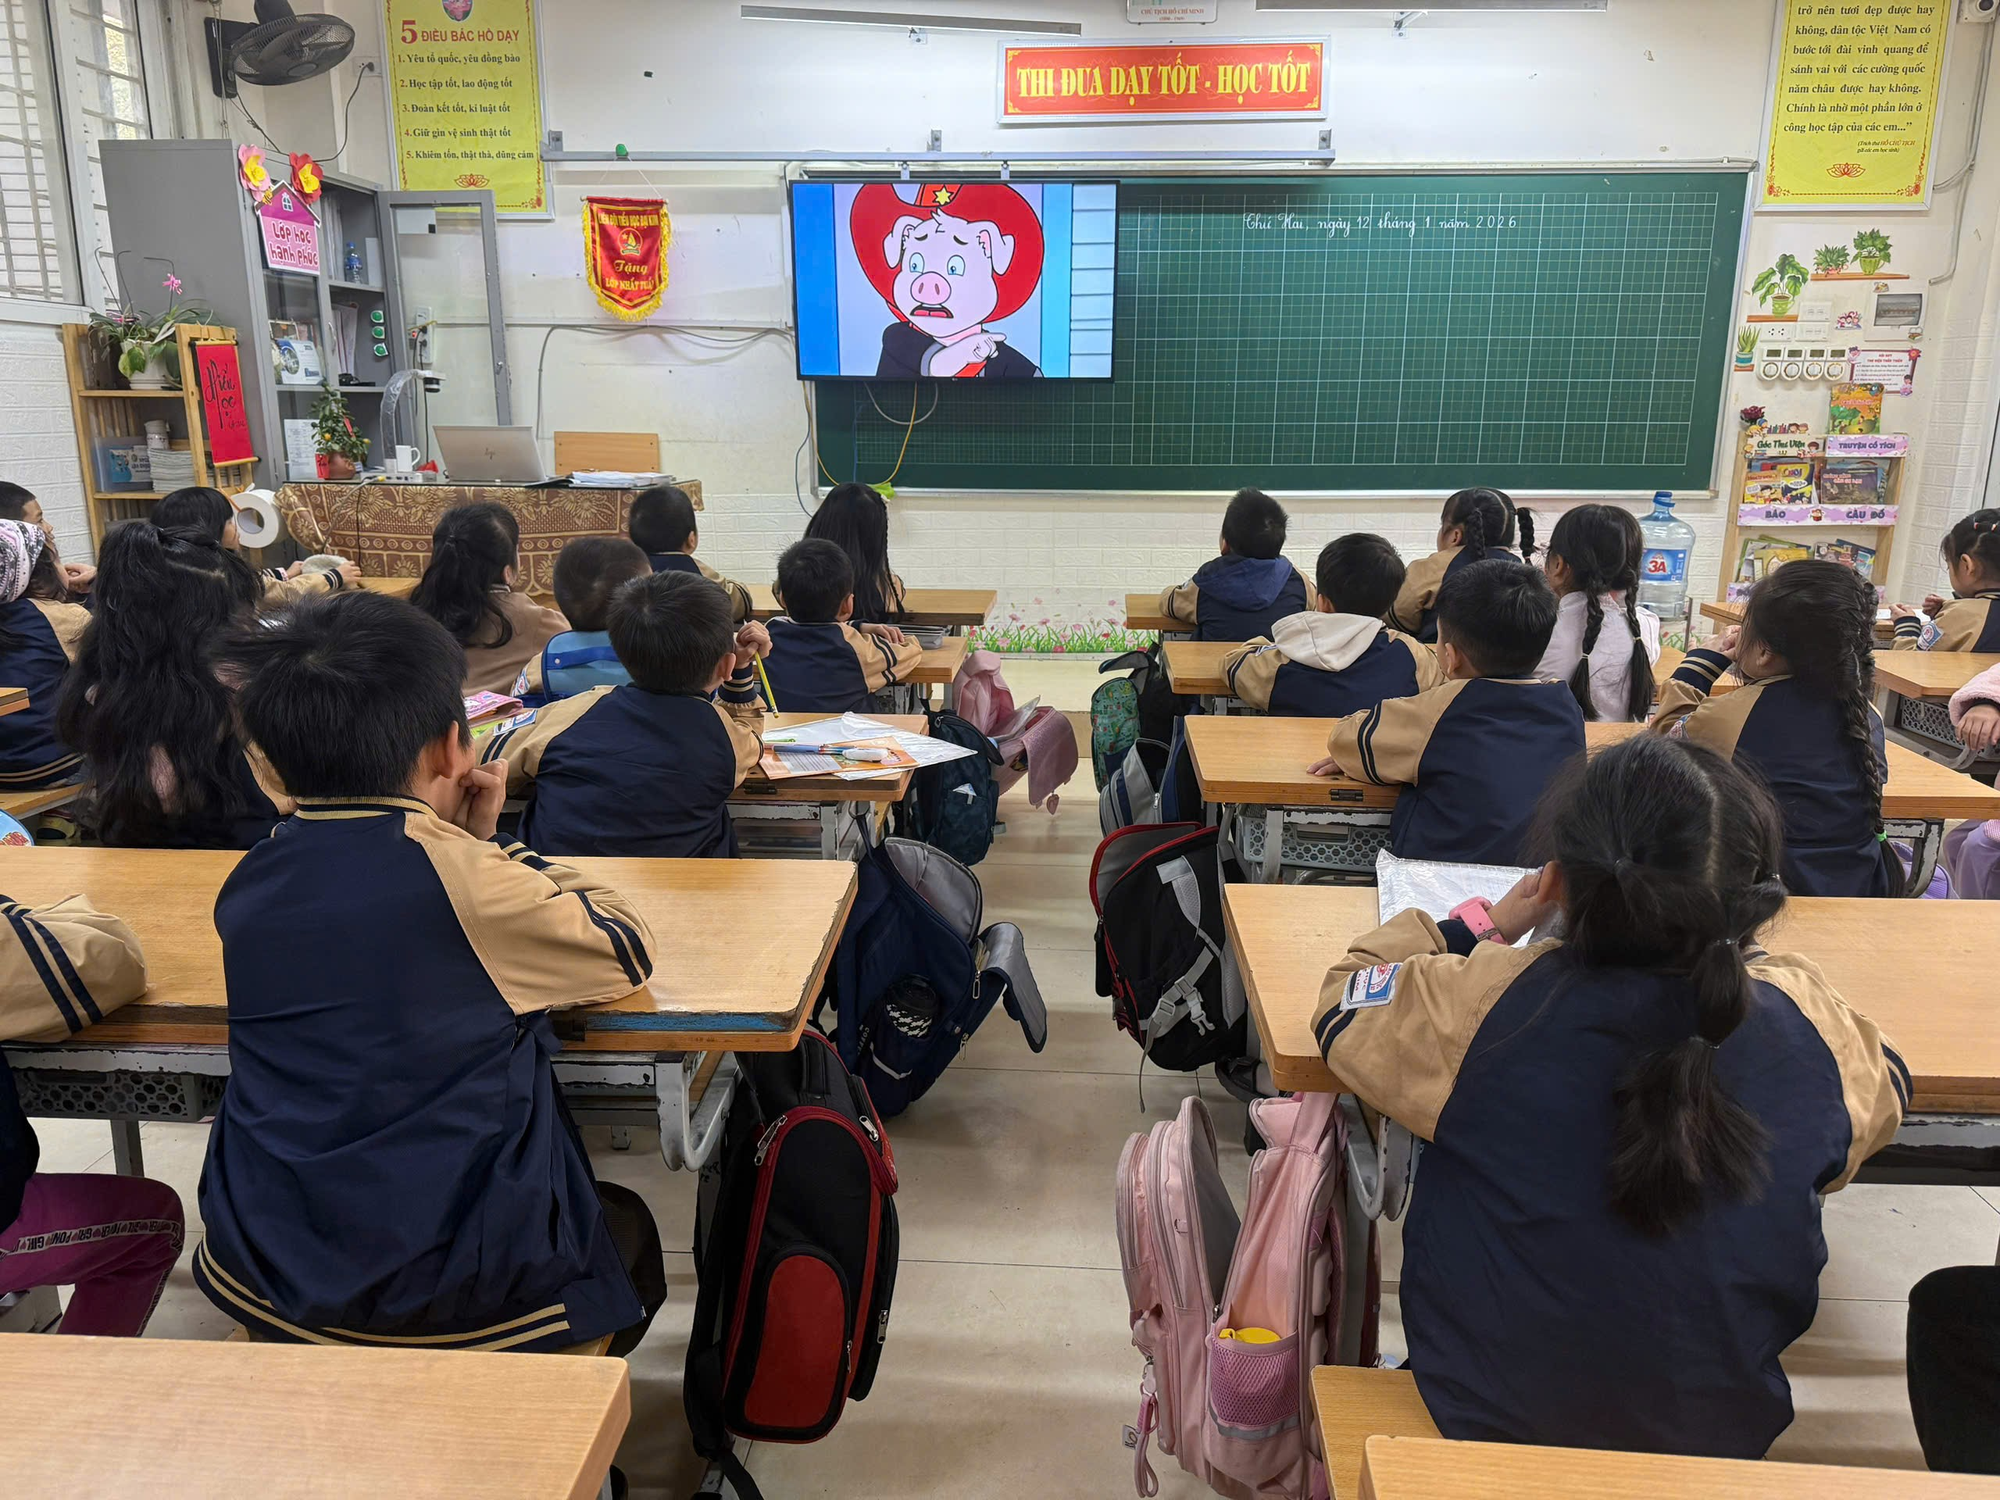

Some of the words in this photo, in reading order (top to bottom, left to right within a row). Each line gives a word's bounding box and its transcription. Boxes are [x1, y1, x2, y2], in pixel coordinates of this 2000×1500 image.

[1798, 5, 1813, 15] trở
[1817, 7, 1835, 15] nên
[1840, 5, 1860, 15] tươi
[1864, 5, 1883, 17] đẹp
[1887, 5, 1911, 17] được
[1916, 5, 1935, 16] hay
[400, 19, 418, 44] 5
[421, 27, 448, 42] ĐIỀU
[450, 28, 475, 42] BÁC
[477, 27, 494, 42] HỒ
[497, 29, 519, 44] DẠY
[1795, 25, 1828, 37] không,
[1830, 25, 1849, 35] dân
[1852, 25, 1866, 36] tộc
[1869, 24, 1888, 36] Việt
[1894, 25, 1917, 34] Nam
[1920, 25, 1931, 34] có
[1793, 44, 1817, 55] bước
[1818, 44, 1831, 55] tới
[1836, 44, 1852, 54] đài
[1857, 44, 1878, 54] vinh
[1883, 46, 1914, 56] quang
[1916, 41, 1930, 54] để
[398, 54, 405, 63] 1.
[406, 54, 424, 63] Yêu
[426, 51, 436, 63] tổ
[438, 52, 462, 65] quốc,
[463, 54, 479, 65] yêu
[481, 51, 503, 65] đồng
[504, 54, 521, 63] bào
[1790, 64, 1813, 74] sánh
[1816, 64, 1830, 74] vai
[1833, 64, 1847, 74] với
[1852, 64, 1868, 74] các
[1870, 64, 1899, 75] cường
[1901, 61, 1926, 75] quốc
[400, 79, 408, 88] 2.
[409, 79, 427, 89] Học
[429, 79, 443, 89] tập
[445, 76, 460, 89] tốt,
[462, 79, 475, 88] lao
[477, 79, 499, 90] động
[501, 76, 513, 88] tốt
[1017, 68, 1054, 97] THI
[1061, 67, 1104, 97] ĐUA
[1109, 65, 1154, 106] DẠY
[1157, 52, 1200, 94] TỐT
[1216, 63, 1263, 105] HỌC
[1267, 50, 1311, 93] TỐT
[1788, 83, 1809, 94] năm
[1811, 83, 1835, 94] châu
[1839, 83, 1864, 95] được
[1868, 83, 1887, 95] hay
[1889, 83, 1922, 95] không.
[402, 104, 410, 113] 3.
[411, 104, 434, 113] Đoàn
[436, 101, 450, 113] kết
[452, 102, 467, 114] tốt,
[480, 104, 497, 115] luật
[499, 101, 511, 113] tốt
[1786, 103, 1816, 113] Chính
[1818, 103, 1827, 113] là
[1829, 103, 1848, 113] nhờ
[1850, 103, 1869, 115] một
[1871, 101, 1896, 114] phần
[1898, 102, 1914, 112] lớn
[1915, 102, 1922, 112] ở
[404, 128, 412, 137] 4.
[413, 128, 430, 137] Giữ
[432, 128, 446, 139] gìn
[448, 129, 458, 139] vệ
[460, 128, 477, 137] sinh
[480, 128, 497, 139] thật
[500, 125, 511, 137] tốt
[1783, 123, 1806, 134] công
[1808, 122, 1825, 134] học
[1827, 122, 1843, 134] tập
[1845, 122, 1863, 132] của
[1865, 122, 1881, 132] các
[406, 151, 414, 159] 5.
[415, 150, 442, 159] Khiêm
[443, 148, 459, 160] tốn,
[461, 150, 477, 161] thật
[479, 150, 494, 160] thà,
[496, 150, 516, 161] dũng
[1243, 212, 1272, 230] Thứ
[1277, 212, 1309, 231] Hai,
[1317, 217, 1351, 238] ngày
[1356, 215, 1370, 229] 12
[1377, 210, 1416, 238] tháng
[1425, 215, 1430, 229] 1
[1438, 218, 1471, 229] năm
[1476, 215, 1517, 229] 2026
[272, 221, 291, 243] Lớp
[293, 226, 311, 246] học
[270, 243, 296, 264] hạnh
[614, 259, 648, 275] Tặng
[1757, 440, 1772, 449] Góc
[1772, 440, 1789, 448] Thư
[1789, 440, 1805, 449] Viện
[1838, 442, 1867, 450] TRUYỆN
[1879, 441, 1896, 449] TÍCH
[1765, 506, 1786, 519] BÁO
[1846, 506, 1866, 519] CÂU
[1870, 508, 1885, 519] ĐỐ
[1648, 560, 1667, 573] 3A
